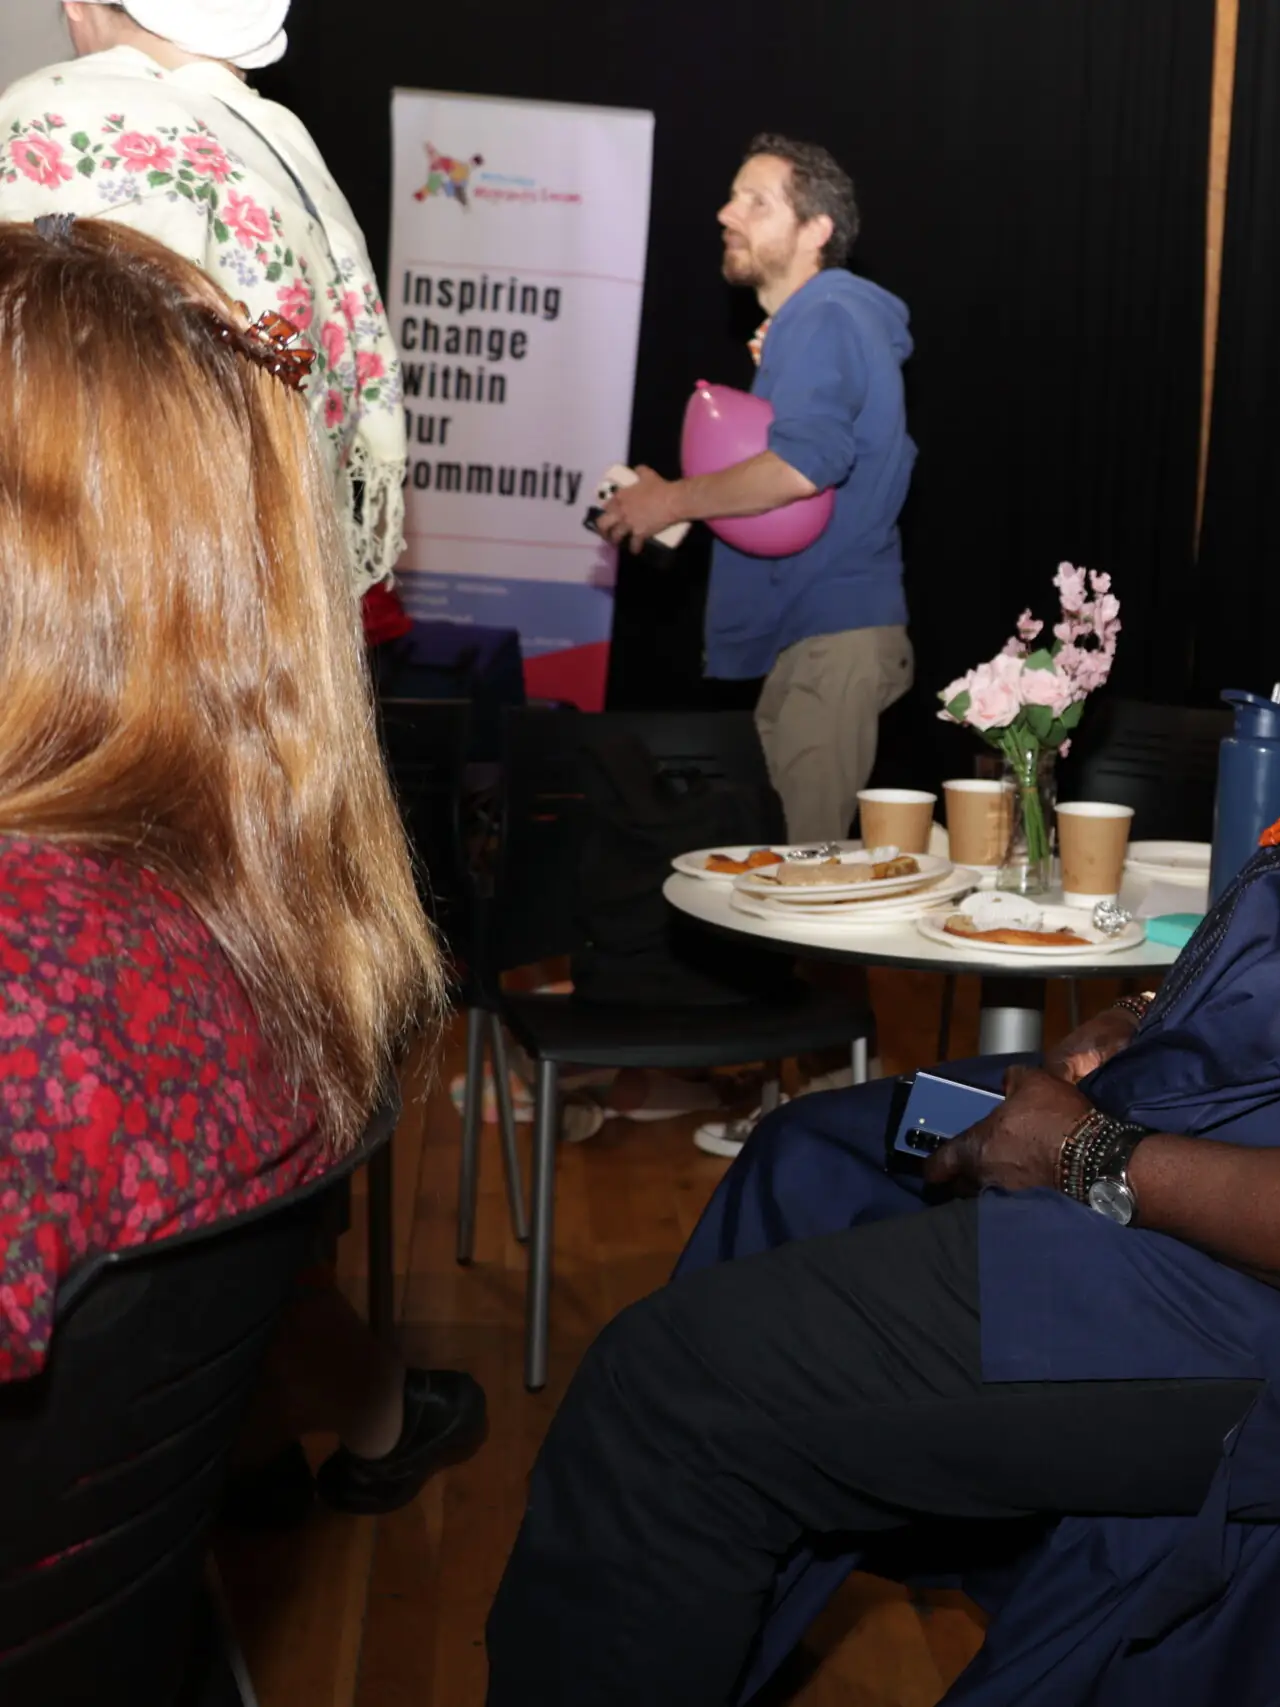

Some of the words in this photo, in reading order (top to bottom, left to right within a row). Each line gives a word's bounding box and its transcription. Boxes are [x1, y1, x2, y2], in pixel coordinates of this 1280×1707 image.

[403, 269, 561, 321] Inspiring
[401, 317, 529, 361] Change
[401, 361, 506, 403] Within
